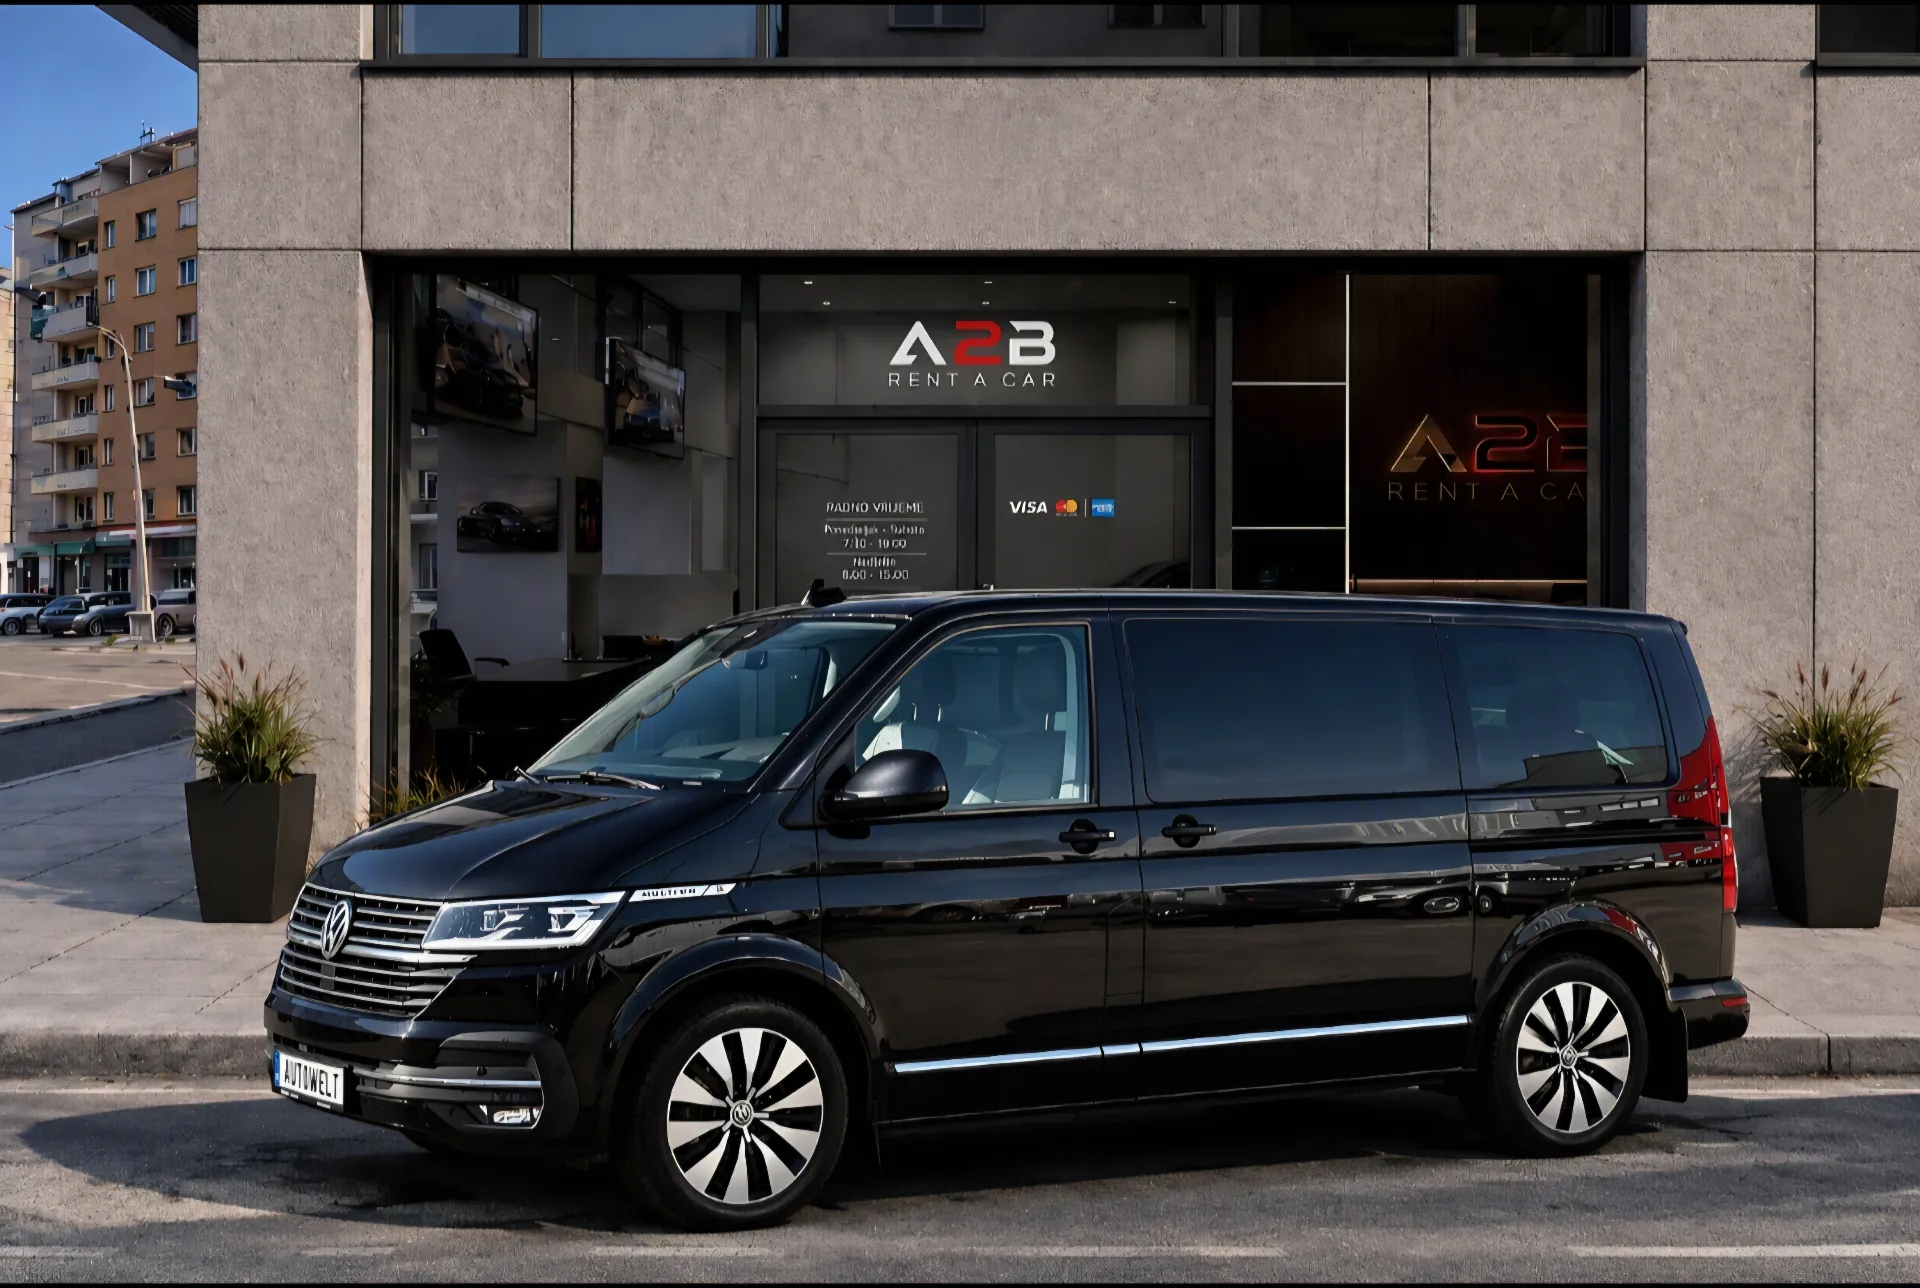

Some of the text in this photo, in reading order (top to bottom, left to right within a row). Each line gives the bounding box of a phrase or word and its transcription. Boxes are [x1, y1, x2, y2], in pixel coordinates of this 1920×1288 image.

[889, 320, 1056, 365] A2B
[888, 372, 1055, 387] RENT A CAR
[1388, 482, 1586, 501] RENT A CA
[1009, 500, 1048, 514] VISA
[284, 1058, 339, 1099] AUTOWELT
